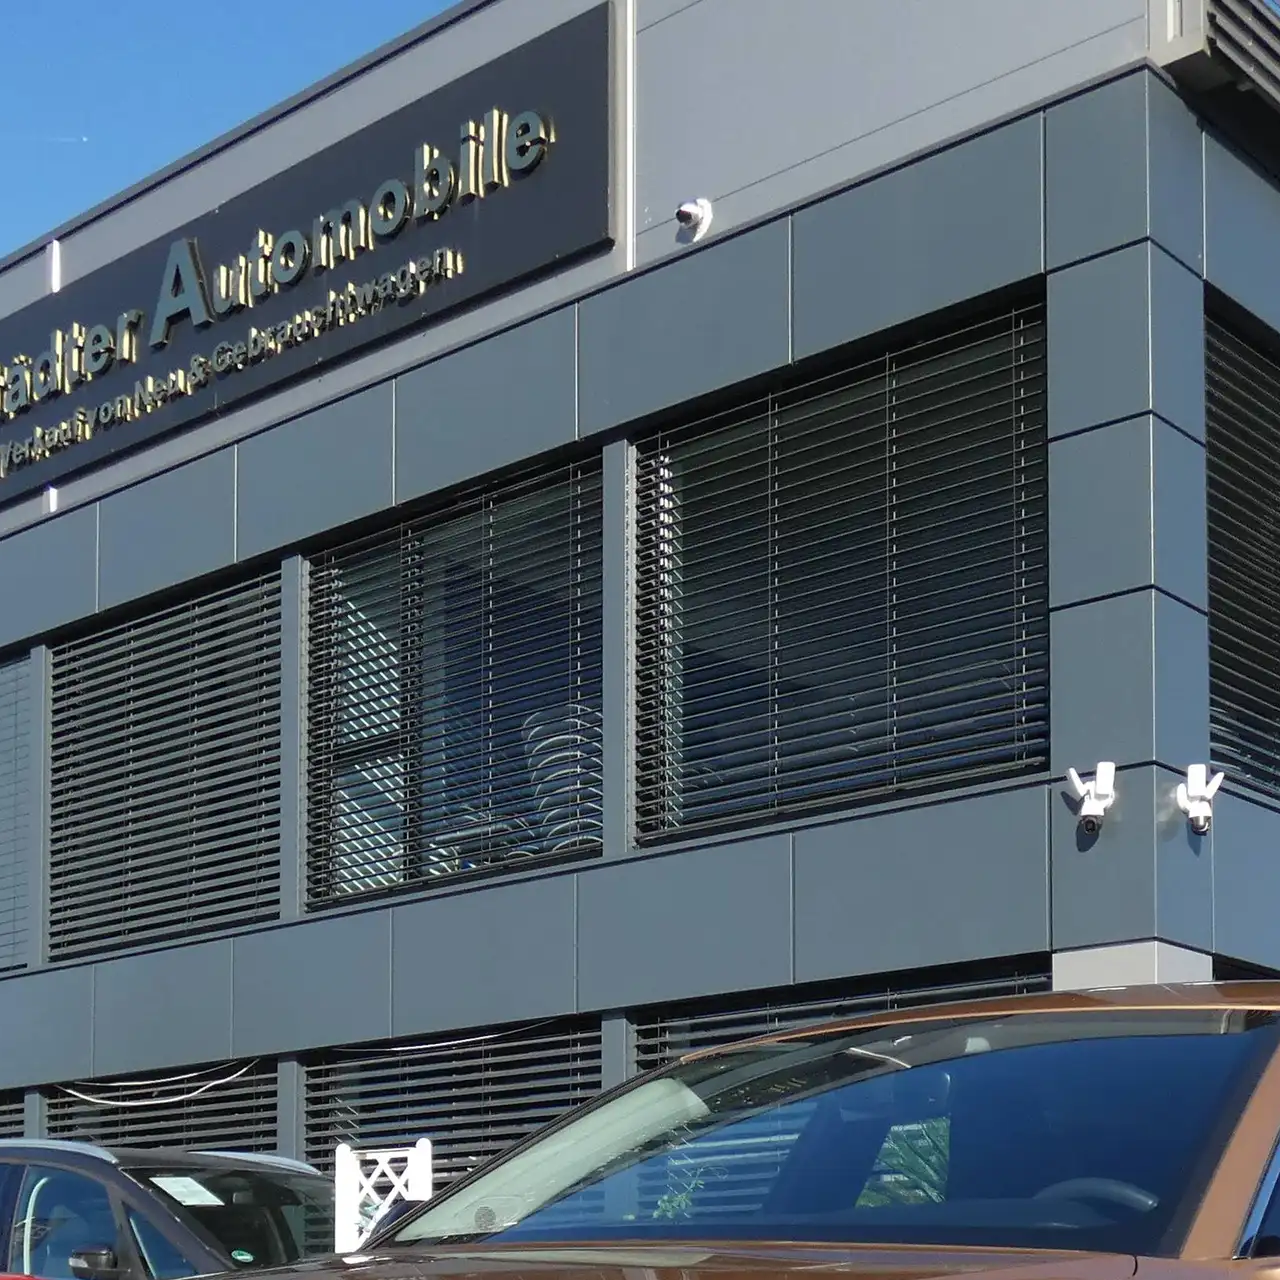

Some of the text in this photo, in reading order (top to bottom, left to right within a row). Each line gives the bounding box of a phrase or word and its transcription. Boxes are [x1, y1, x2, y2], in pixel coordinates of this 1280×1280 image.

[148, 104, 556, 349] Automobile
[85, 395, 133, 440] von
[188, 354, 211, 387] &
[212, 247, 465, 373] Gebrauchtwagen
